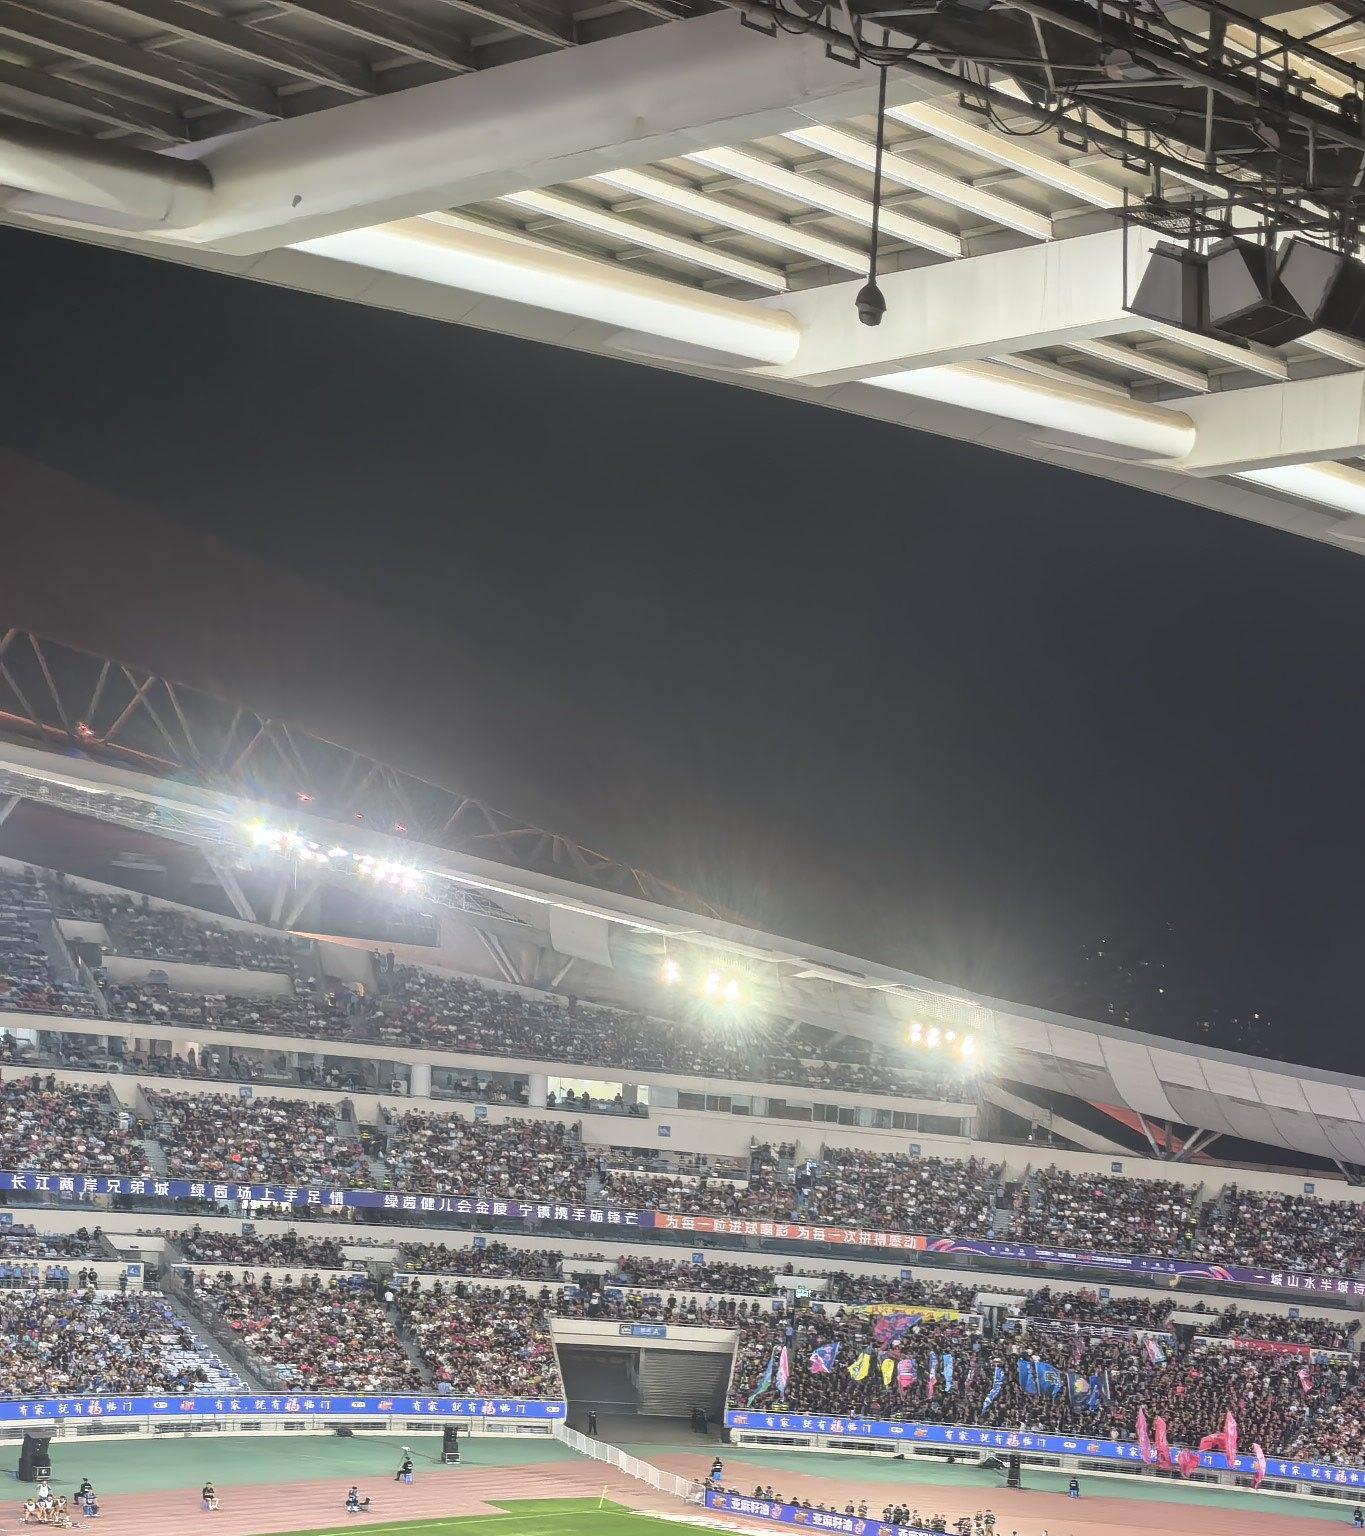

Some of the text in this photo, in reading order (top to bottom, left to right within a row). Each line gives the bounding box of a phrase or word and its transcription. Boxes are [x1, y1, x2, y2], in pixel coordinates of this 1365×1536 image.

[10, 1174, 344, 1205] 长江两岸兄弟城 绿茵场上手足情
[384, 1195, 508, 1216] 绿茵健儿会金陵
[1253, 1273, 1365, 1295] 一城山水半城诗
[730, 1498, 770, 1517] 亚麻籽油
[812, 1512, 853, 1533] 亚麻籽油
